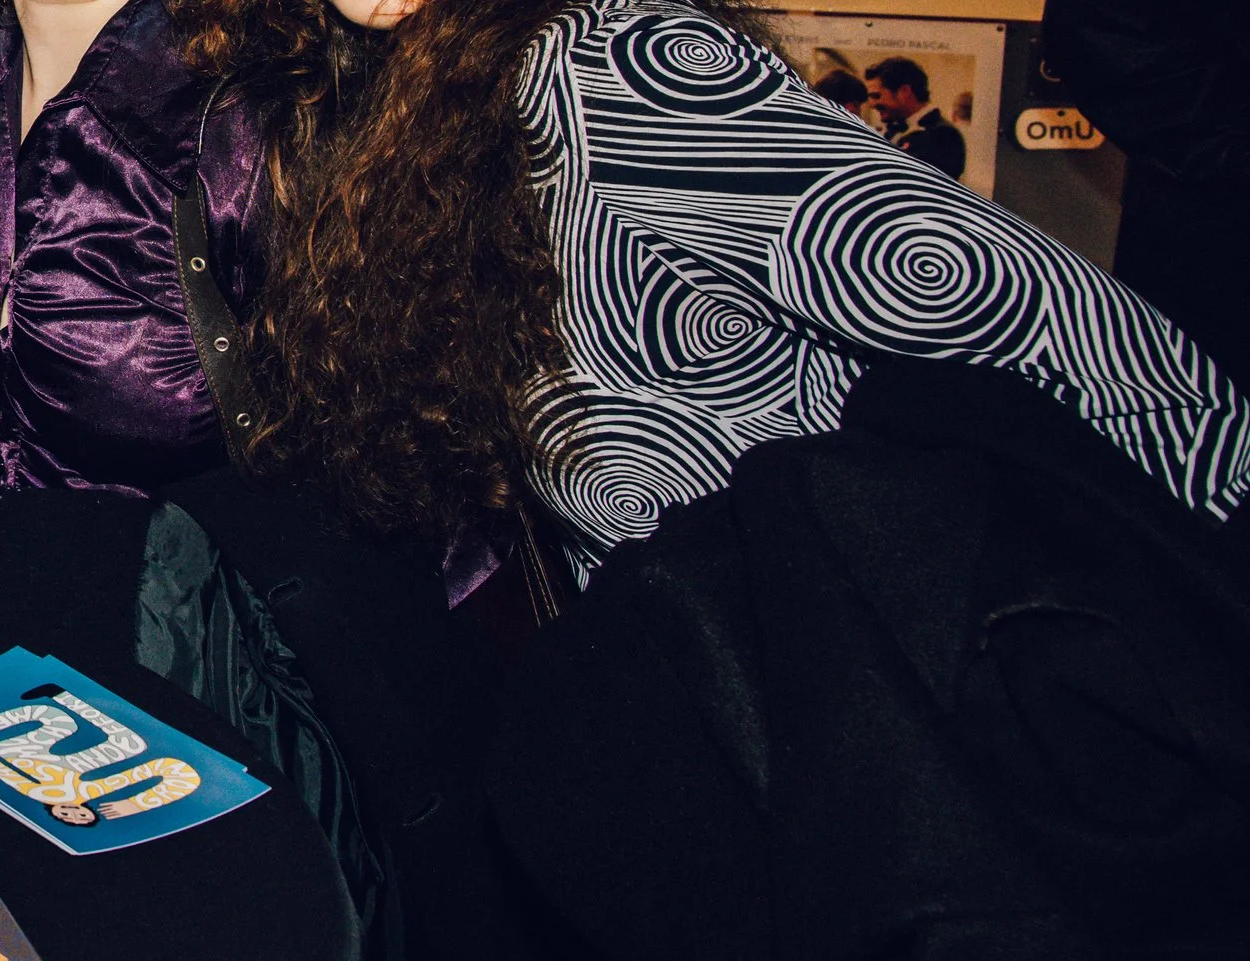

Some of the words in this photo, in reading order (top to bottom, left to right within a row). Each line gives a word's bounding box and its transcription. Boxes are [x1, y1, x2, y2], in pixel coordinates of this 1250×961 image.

[1027, 120, 1094, 141] OmU
[53, 692, 148, 754] EFFORT
[64, 740, 126, 774] AND
[104, 757, 201, 810] GROWING
